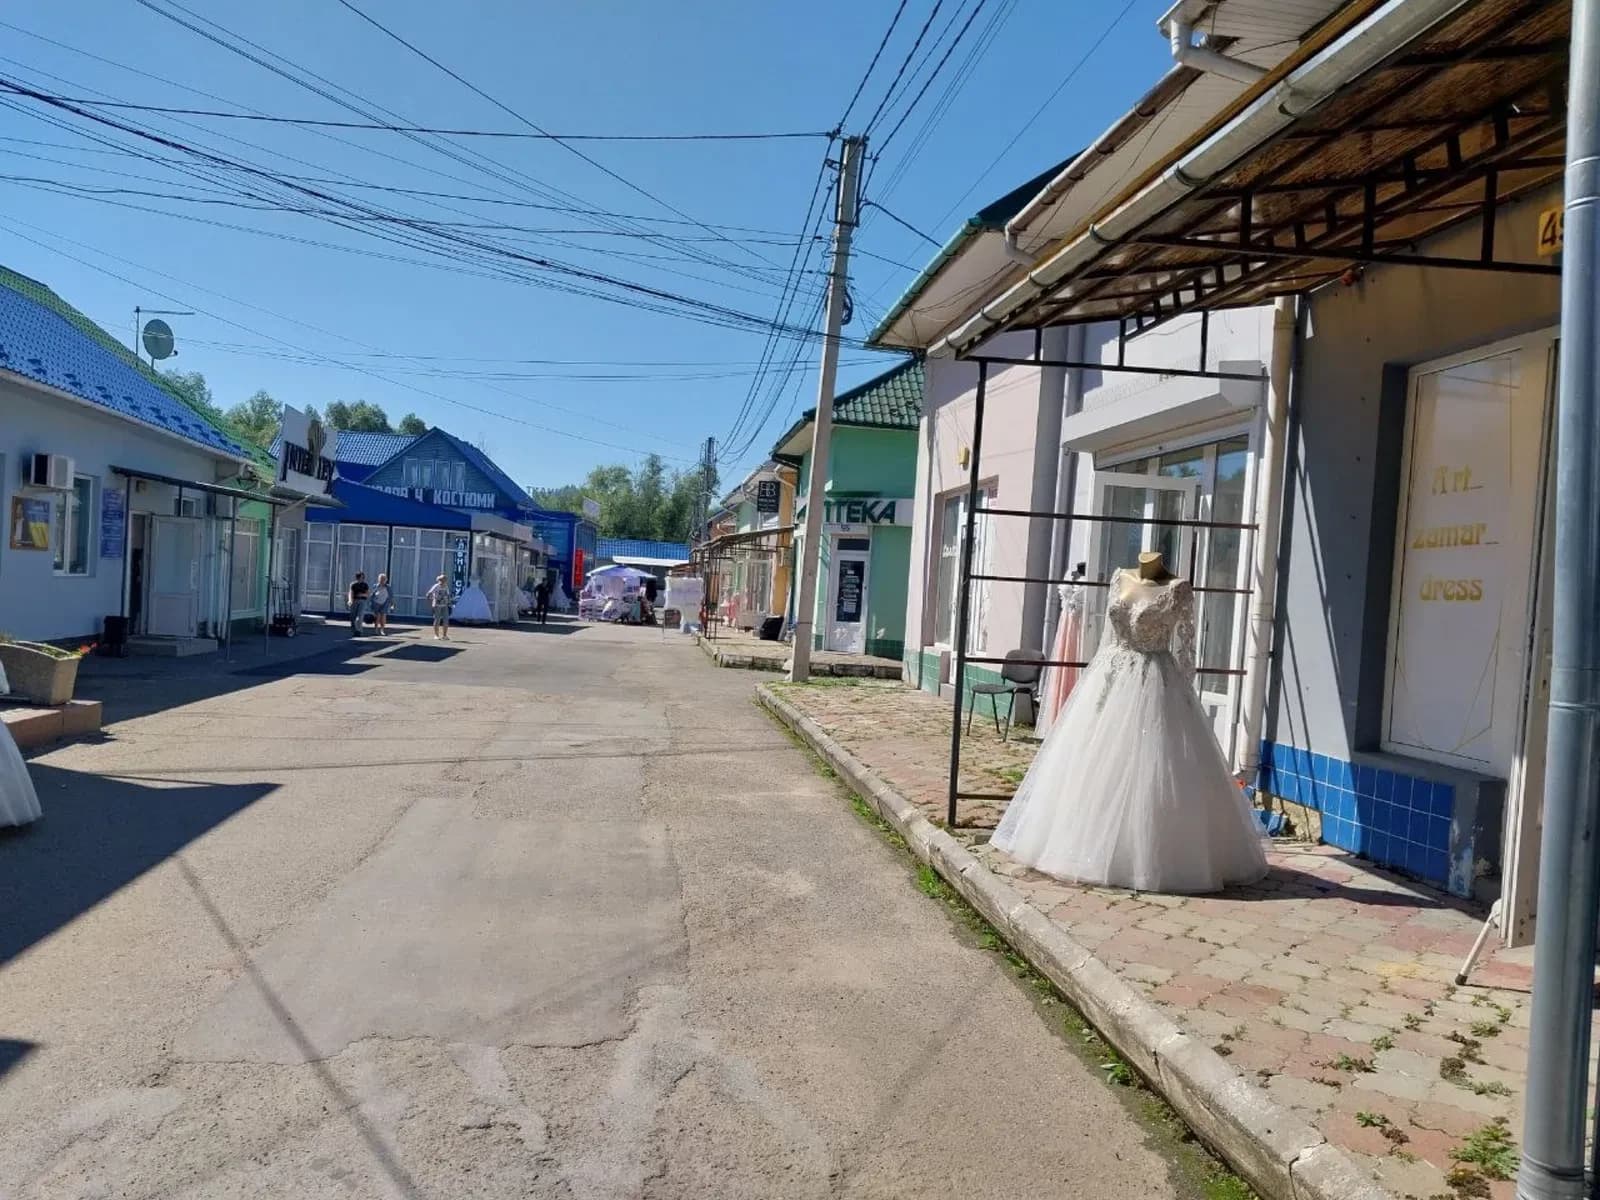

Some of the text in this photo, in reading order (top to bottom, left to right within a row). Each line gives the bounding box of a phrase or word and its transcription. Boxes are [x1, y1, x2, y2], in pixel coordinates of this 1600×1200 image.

[1541, 211, 1564, 246] 4
[433, 488, 496, 508] КОСТЮМИ
[1420, 573, 1483, 601] dress
